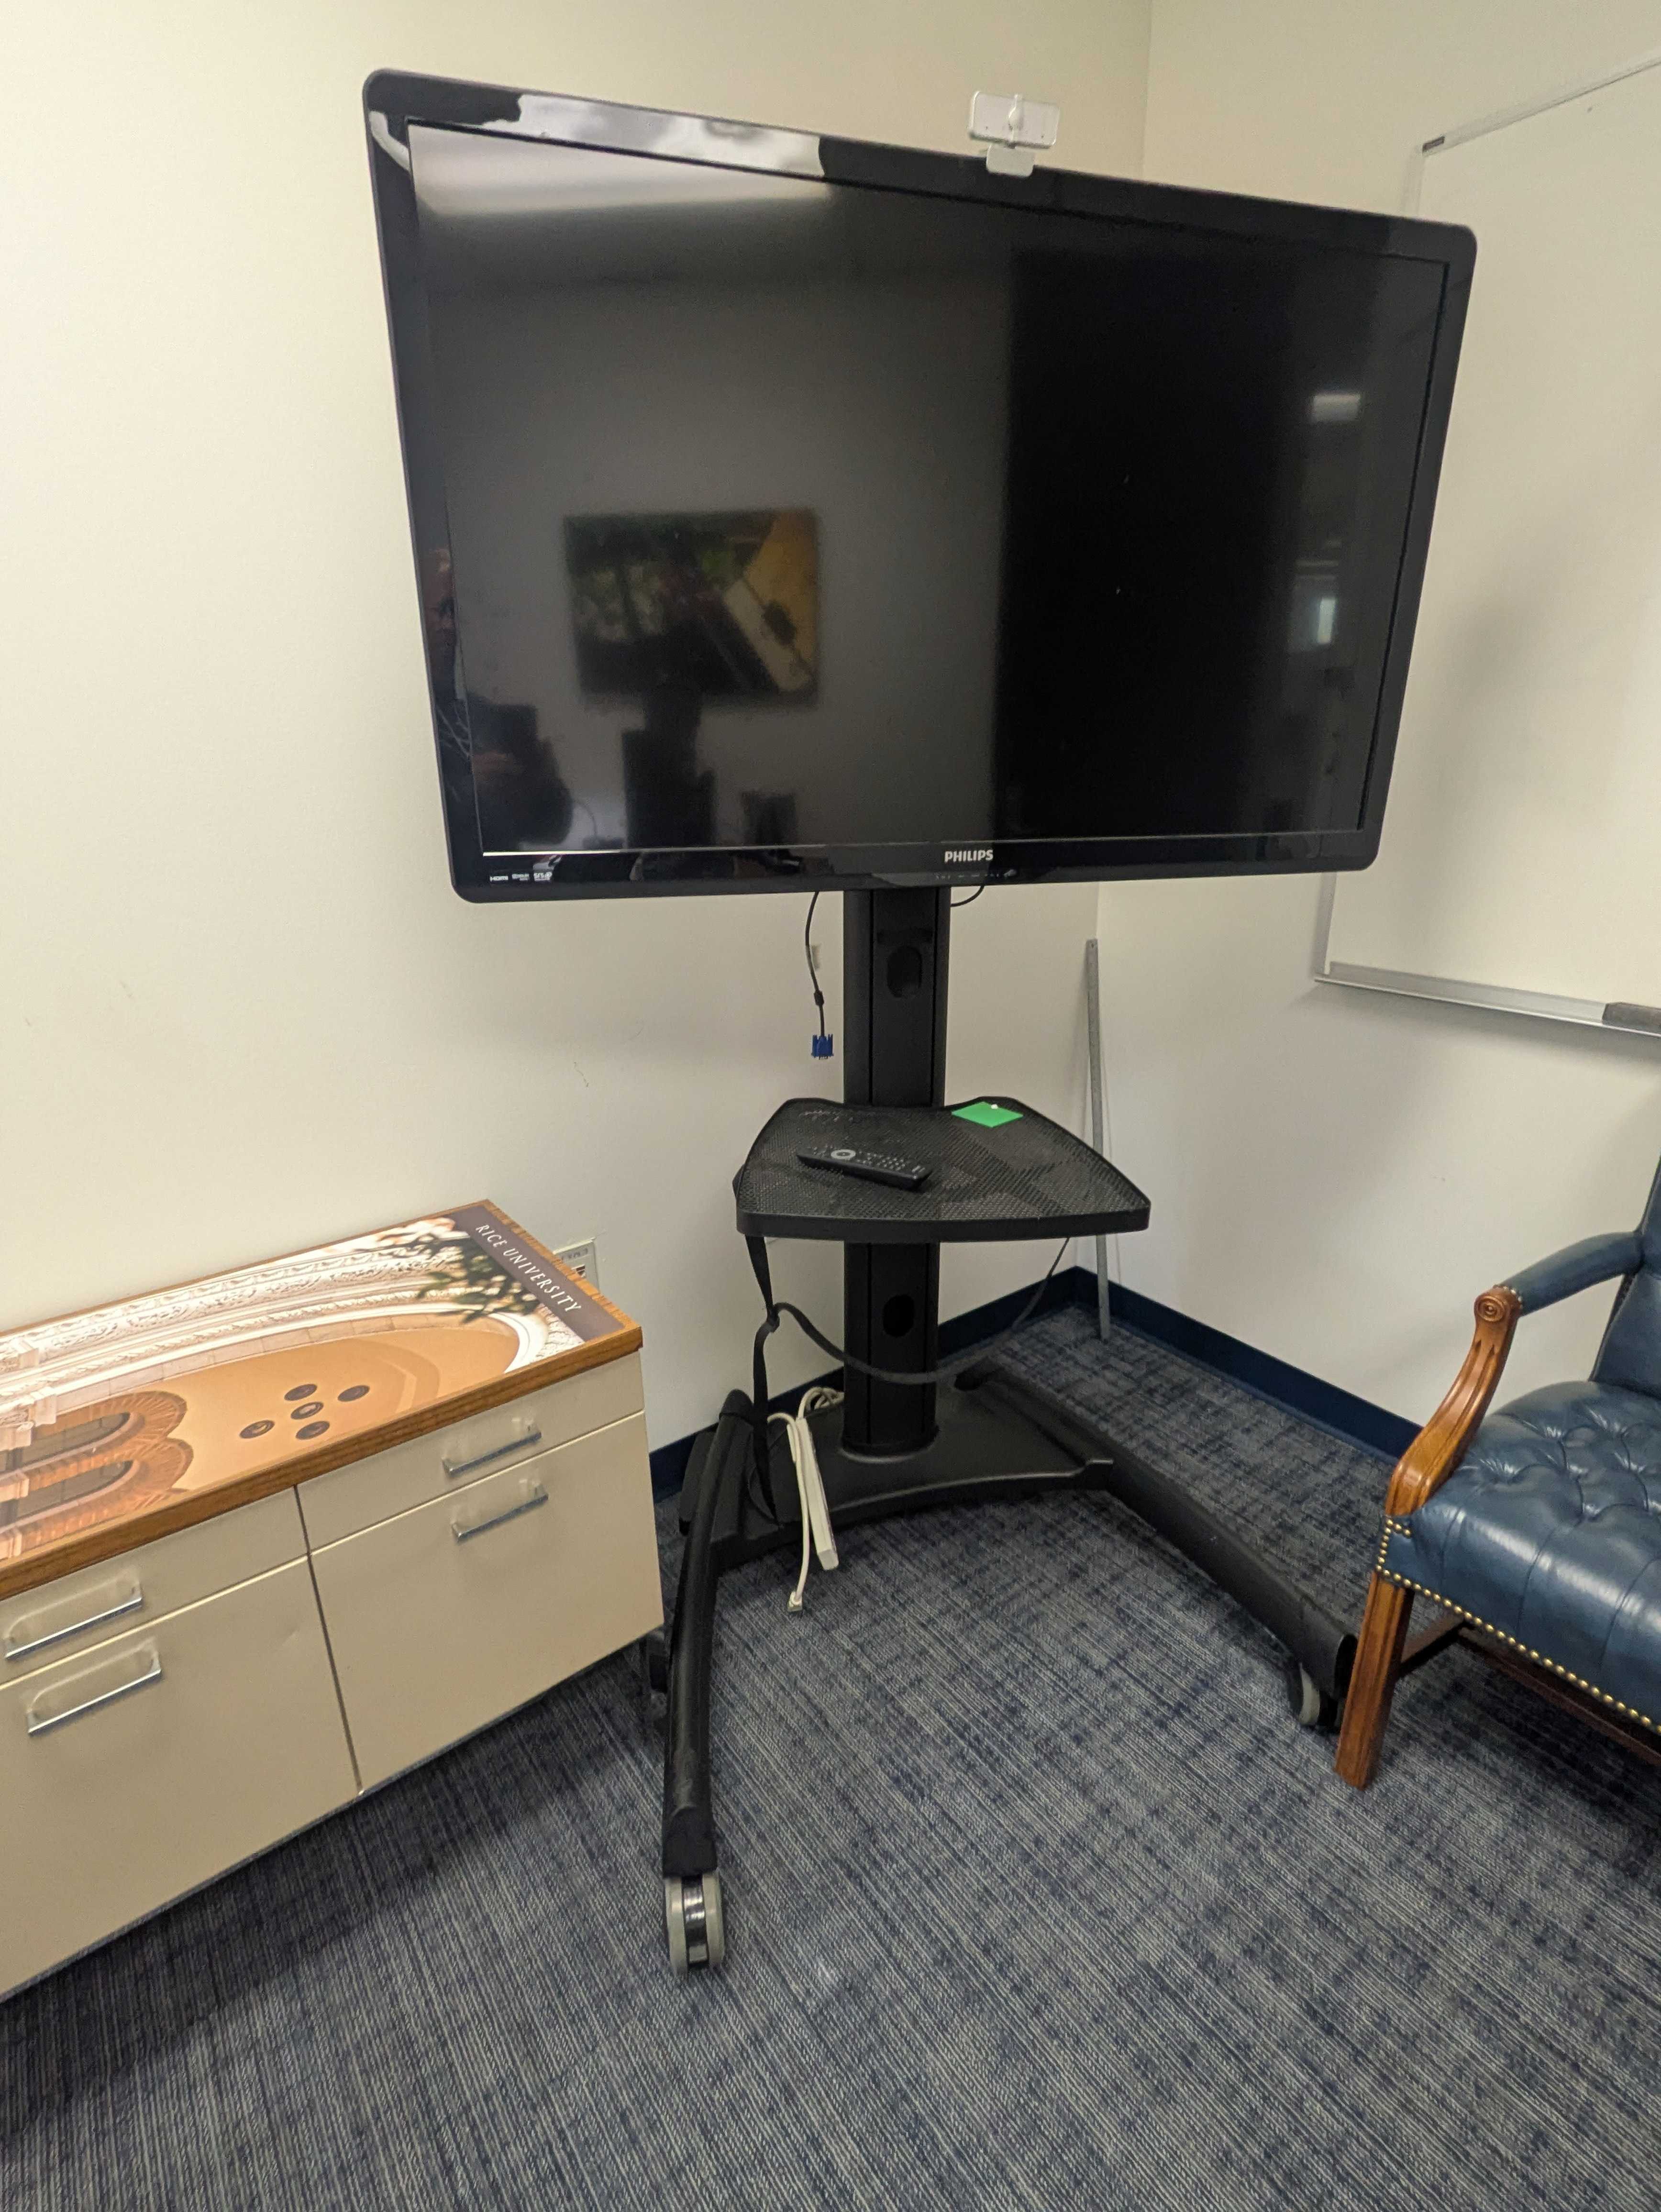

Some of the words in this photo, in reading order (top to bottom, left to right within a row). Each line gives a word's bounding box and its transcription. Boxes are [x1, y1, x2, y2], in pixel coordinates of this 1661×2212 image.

[944, 850, 993, 863] PHILIPS
[476, 1225, 508, 1248] RICE
[503, 1248, 582, 1312] UNIVERSITY
